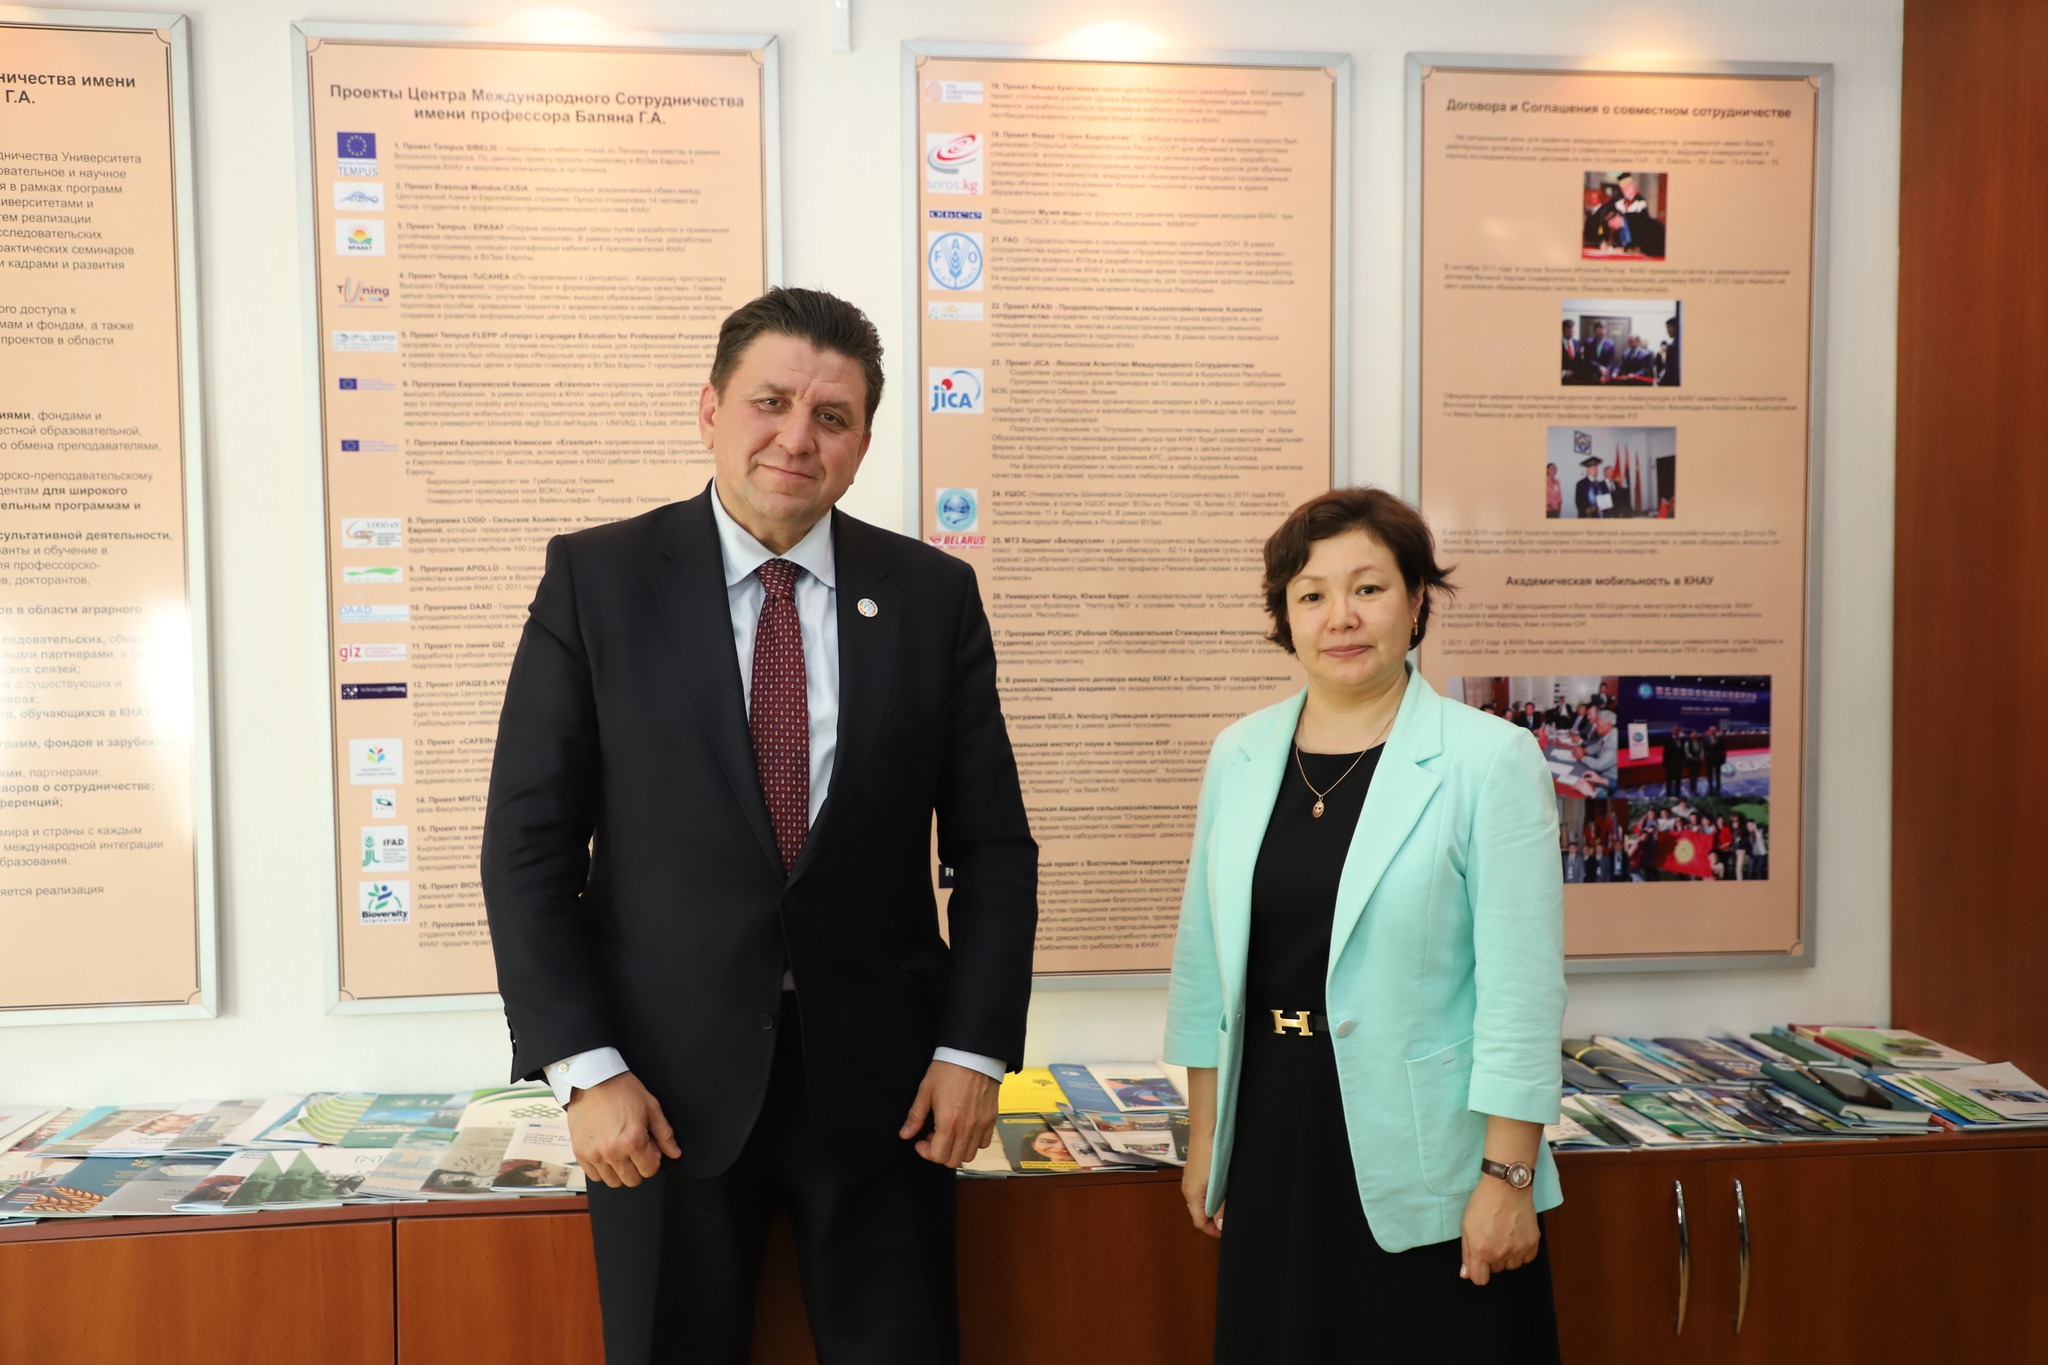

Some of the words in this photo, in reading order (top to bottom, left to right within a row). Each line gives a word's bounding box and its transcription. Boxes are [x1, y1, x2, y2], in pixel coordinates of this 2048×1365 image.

[81, 75, 136, 89] имени
[5, 88, 37, 104] Г.А.
[329, 83, 403, 103] Проекты
[407, 86, 467, 105] Центра
[471, 88, 611, 107] Международного
[615, 93, 745, 110] Сотрудничества
[1446, 98, 1507, 114] Договора
[1509, 103, 1519, 112] и
[1520, 100, 1600, 115] Соглашения
[1601, 104, 1611, 115] о
[1612, 104, 1690, 117] совместном
[1691, 106, 1792, 121] сотрудничестве
[413, 108, 467, 123] имени
[470, 110, 571, 126] профессора
[575, 109, 634, 125] Баляна
[638, 110, 666, 125] Г.А.
[338, 166, 379, 177] TEMPUS
[927, 178, 979, 195] soros.kg
[944, 536, 987, 545] BELARUS
[1505, 576, 1593, 587] Академическая
[1594, 575, 1672, 587] мобильность
[1673, 577, 1682, 586] в
[1683, 575, 1715, 586] КНАУ
[340, 605, 372, 615] DAAD
[340, 645, 361, 662] giz
[382, 838, 405, 847] IFAD
[361, 910, 408, 919] Bioversity
